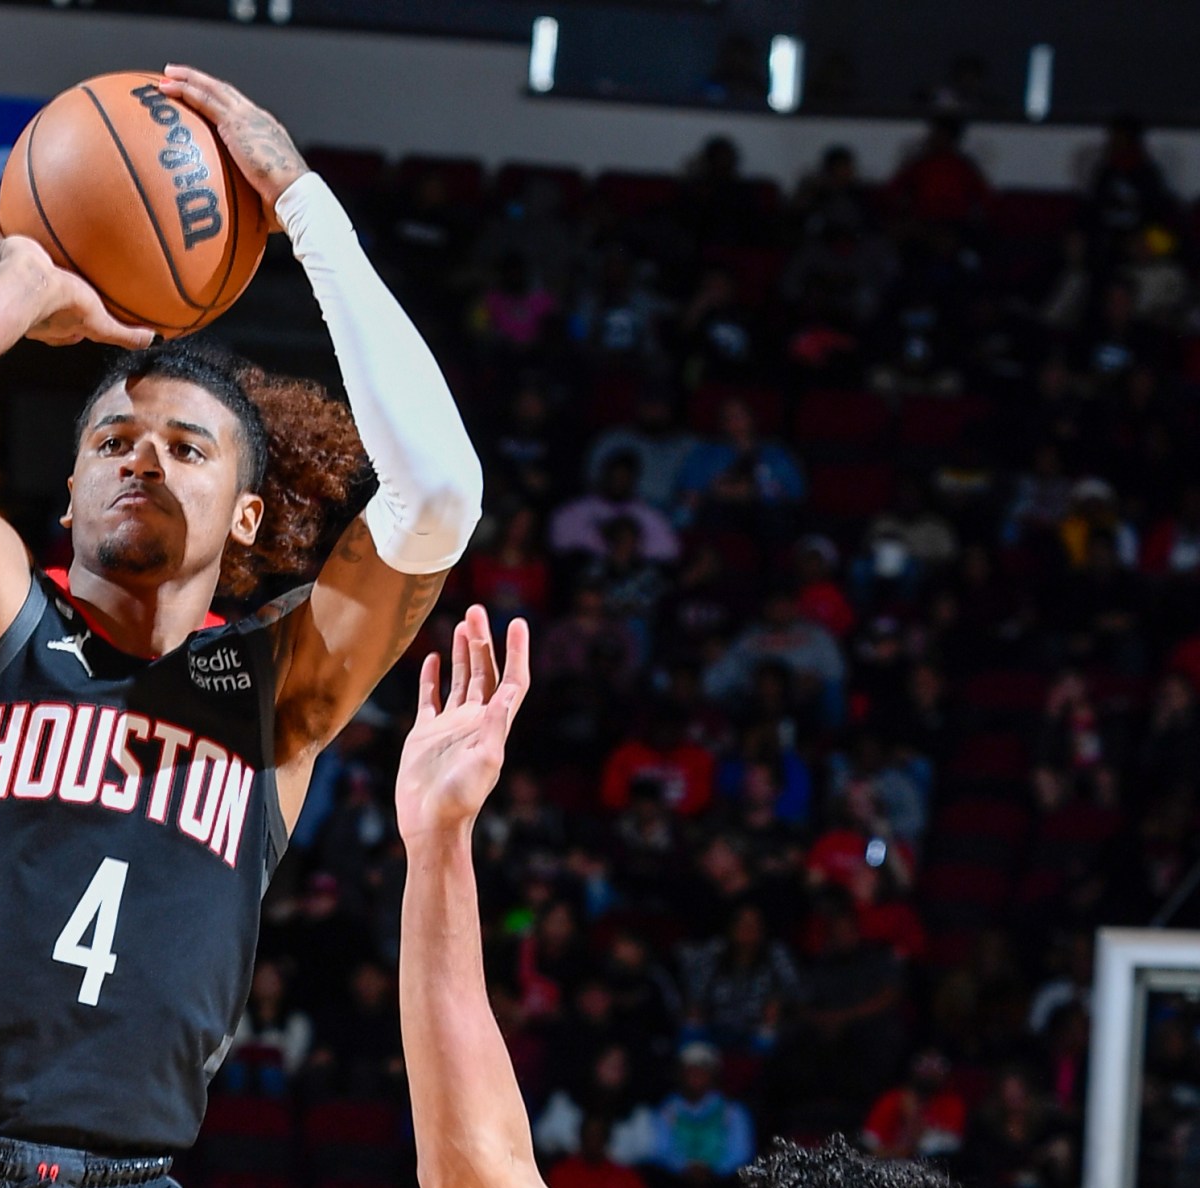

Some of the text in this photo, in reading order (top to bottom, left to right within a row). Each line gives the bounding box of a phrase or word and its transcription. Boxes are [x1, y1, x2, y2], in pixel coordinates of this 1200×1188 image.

[130, 84, 223, 252] Wilson
[190, 671, 252, 692] arma
[52, 856, 130, 1006] 4
